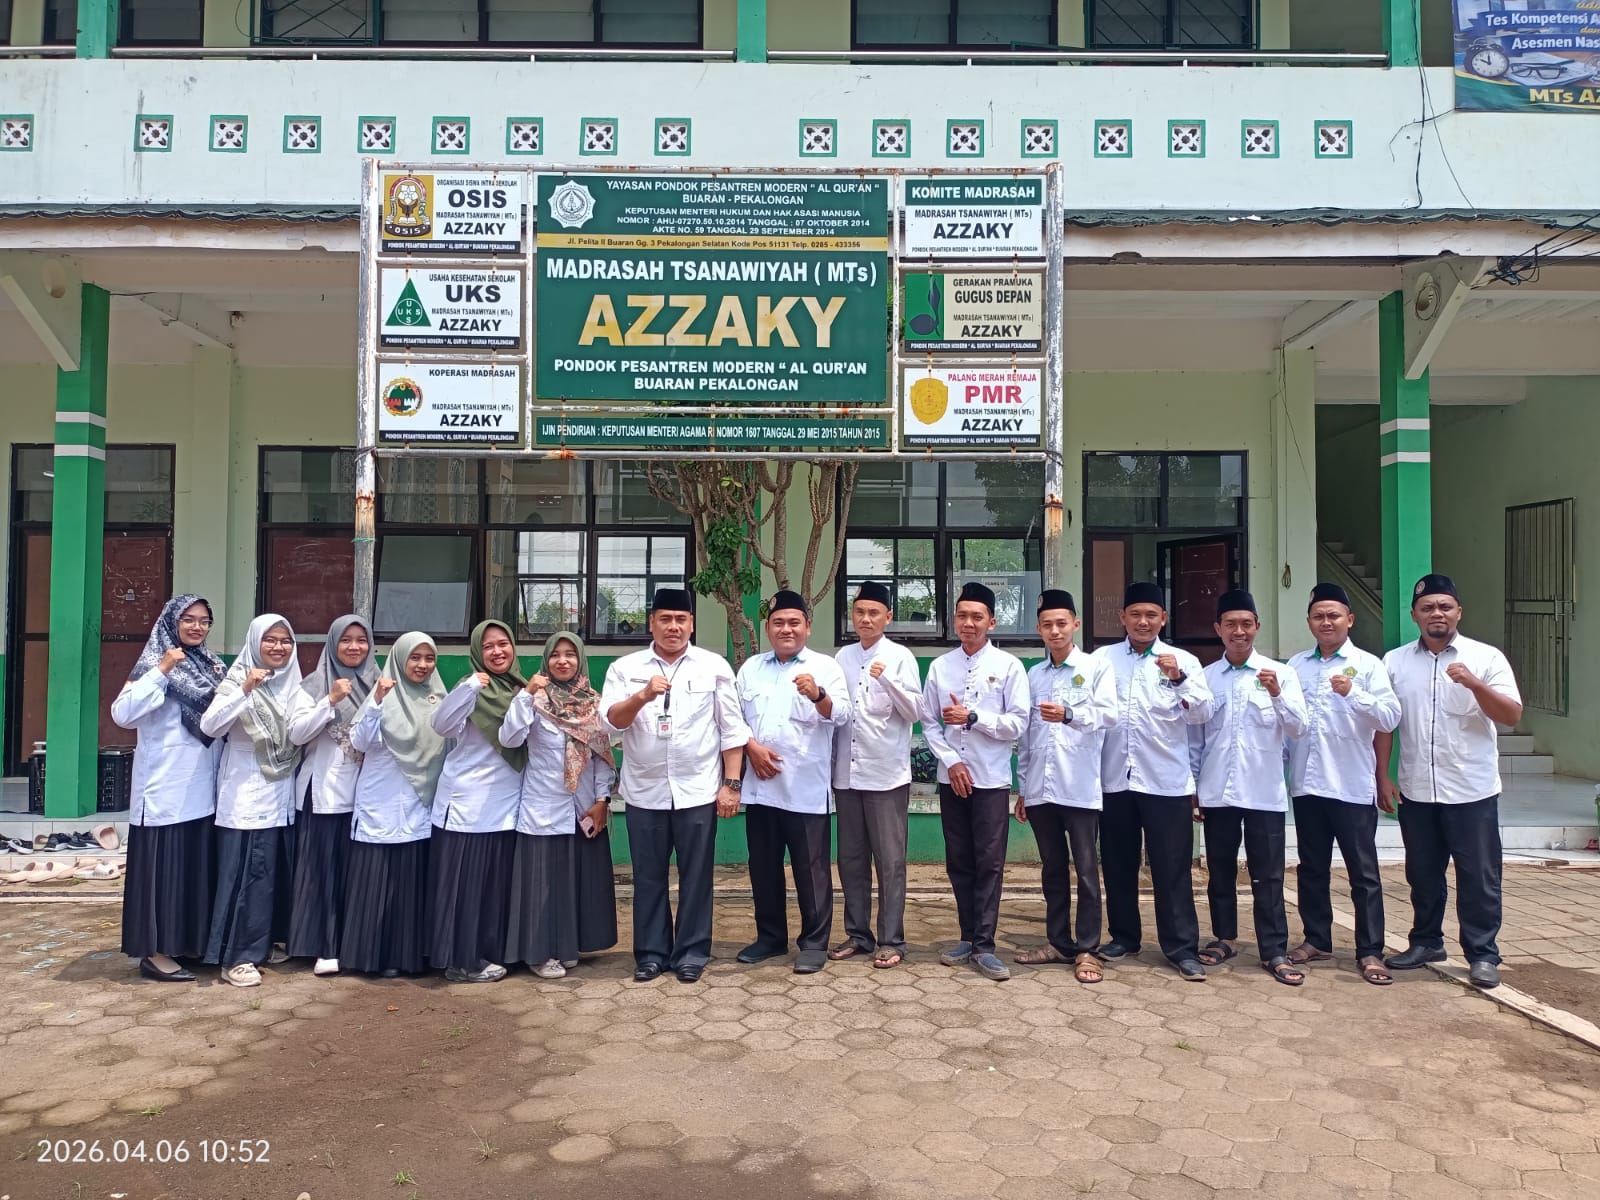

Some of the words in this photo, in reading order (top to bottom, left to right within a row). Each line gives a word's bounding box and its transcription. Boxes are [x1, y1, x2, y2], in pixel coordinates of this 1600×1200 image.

[1486, 14, 1508, 26] Tes
[1511, 12, 1588, 26] Kompetensi
[1512, 37, 1572, 50] Asesmen
[1529, 88, 1574, 103] MTs
[1579, 89, 1600, 103] A
[607, 181, 652, 190] YAYASAN
[655, 181, 698, 191] PONDOK
[701, 182, 762, 192] PESANTREN
[764, 183, 808, 192] MODERN
[818, 183, 831, 193] AL
[833, 183, 872, 193] QUR'AN
[911, 186, 960, 198] KOMITE
[964, 186, 1035, 198] MADRASAH
[448, 189, 507, 209] OSIS
[683, 194, 725, 204] BUARAN
[734, 195, 804, 205] PEKALONGAN
[625, 207, 677, 215] KEPUTUSAN
[914, 209, 957, 218] MADRASAH
[958, 209, 1007, 218] TSANAWIYAH
[443, 222, 506, 235] AZZAKY
[748, 218, 788, 226] TANGGAL
[807, 219, 848, 227] OKTOBER
[394, 227, 421, 235] OSIS
[678, 226, 693, 234] NO.
[761, 227, 814, 235] SEPTEMBER
[933, 223, 1014, 239] AZZAKY
[607, 238, 634, 246] Buaran
[636, 239, 648, 248] Gg.
[657, 239, 700, 248] Pekalongan
[702, 239, 729, 247] Selatan
[752, 240, 767, 248] Pos
[792, 241, 808, 249] Telp.
[546, 258, 664, 280] MADRASAH
[670, 260, 808, 282] TSANAWIYAH
[429, 274, 450, 282] USAHA
[451, 274, 487, 282] KESEHATAN
[487, 274, 516, 283] SEKOLAH
[953, 278, 992, 287] GERAKAN
[993, 278, 1033, 287] PRAMUKA
[445, 284, 501, 303] UKS
[954, 290, 993, 304] GUGUS
[996, 290, 1032, 303] DEPAN
[439, 318, 502, 332] AZZAKY
[577, 294, 847, 348] AZZAKY
[961, 325, 1023, 338] AZZAKY
[429, 369, 469, 377] KOPERASI
[471, 369, 516, 377] MADRASAH
[554, 359, 617, 372] PONDOK
[620, 360, 708, 373] PESANTREN
[712, 361, 775, 374] MODERN
[789, 362, 808, 374] AL
[812, 362, 867, 375] QUR'AN
[634, 377, 695, 390] BUARAN
[699, 378, 799, 391] PEKALONGAN
[948, 374, 977, 382] PALANG
[978, 374, 1005, 382] MERAH
[1007, 374, 1037, 382] REMAJA
[965, 385, 1023, 404] PMR
[440, 414, 503, 427] AZZAKY
[961, 419, 1023, 432] AZZAKY
[542, 424, 555, 436] IJIN
[557, 424, 596, 436] PENDIRIAN
[601, 425, 646, 437] KEPUTUSAN
[647, 426, 679, 437] MENTERI
[679, 426, 707, 437] AGAMA
[716, 426, 743, 438] NOMOR
[745, 427, 760, 438] 1607
[762, 427, 796, 438] TANGGAL
[797, 427, 806, 438] 29
[807, 427, 820, 438] MEI
[821, 427, 837, 438] 2015
[839, 427, 863, 439] TAHUN
[864, 428, 881, 439] 2015
